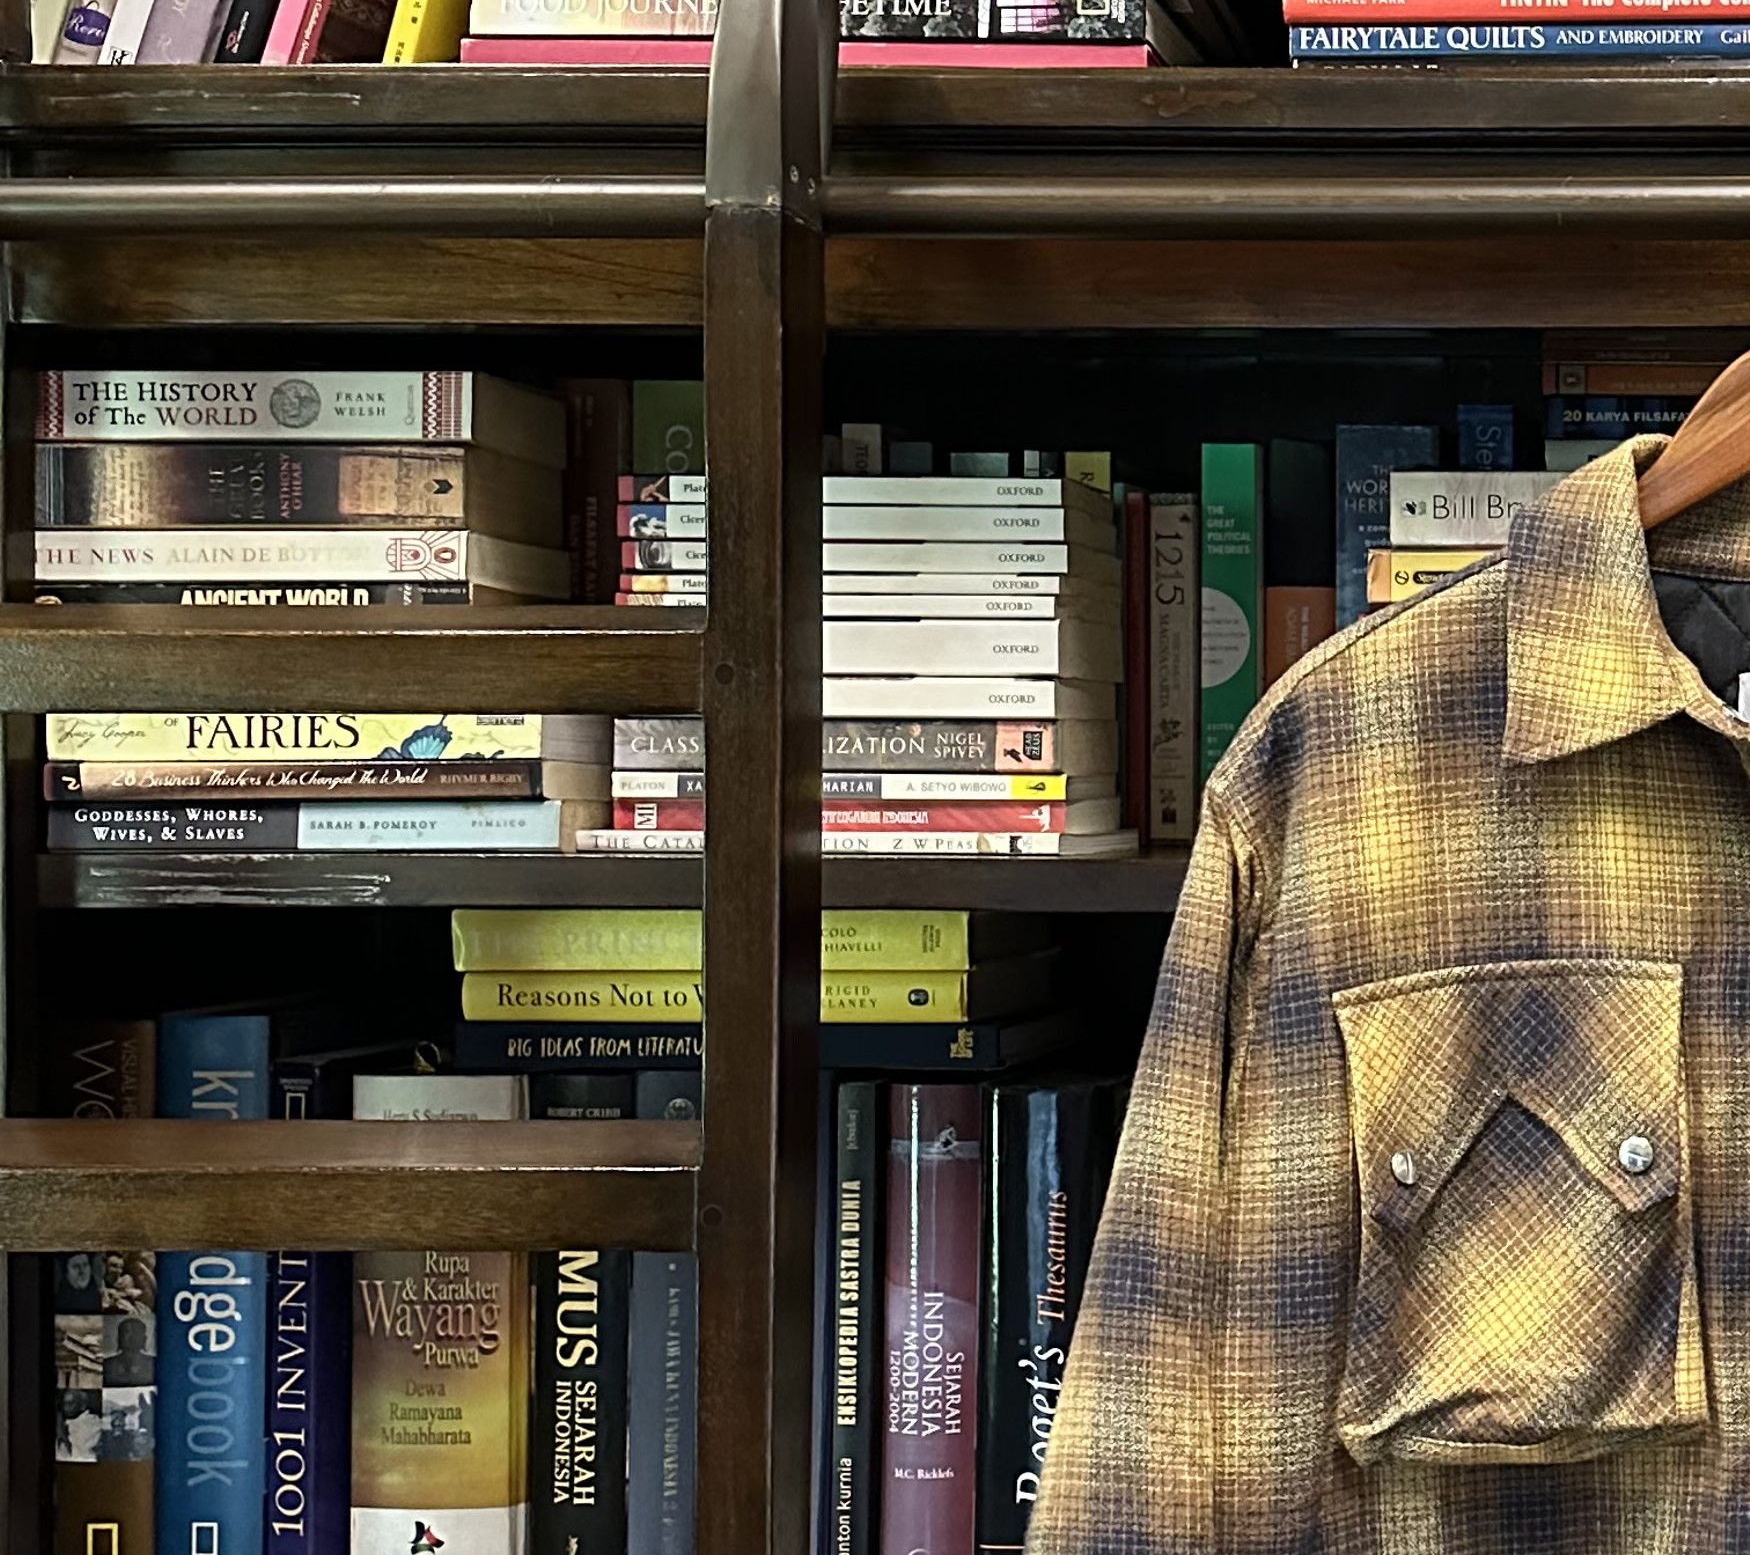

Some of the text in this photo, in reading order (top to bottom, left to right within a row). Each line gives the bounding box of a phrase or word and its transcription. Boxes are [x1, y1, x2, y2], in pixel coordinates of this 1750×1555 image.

[1300, 26, 1703, 49] FAIRYTALE QUILTS AND EMBROIDERY
[73, 381, 258, 402] THE HISTORY
[336, 393, 386, 403] FRANK
[74, 407, 258, 427] of The WORLD
[334, 405, 386, 417] WELSH
[997, 486, 1043, 497] OXFORD
[998, 553, 1045, 564] OXFORD
[186, 715, 360, 750] FAIRIES
[936, 733, 985, 746] NIGEL
[934, 746, 986, 759] SPIVEY
[184, 826, 245, 841] SLAVES
[498, 983, 687, 1007] Reasons Not to
[838, 1180, 861, 1426] ENSIKLOPEDIA SASTRA DUNIA
[360, 1280, 500, 1352] Wayang
[555, 1381, 570, 1503] INDONESIA
[575, 1381, 595, 1507] SEJARAH
